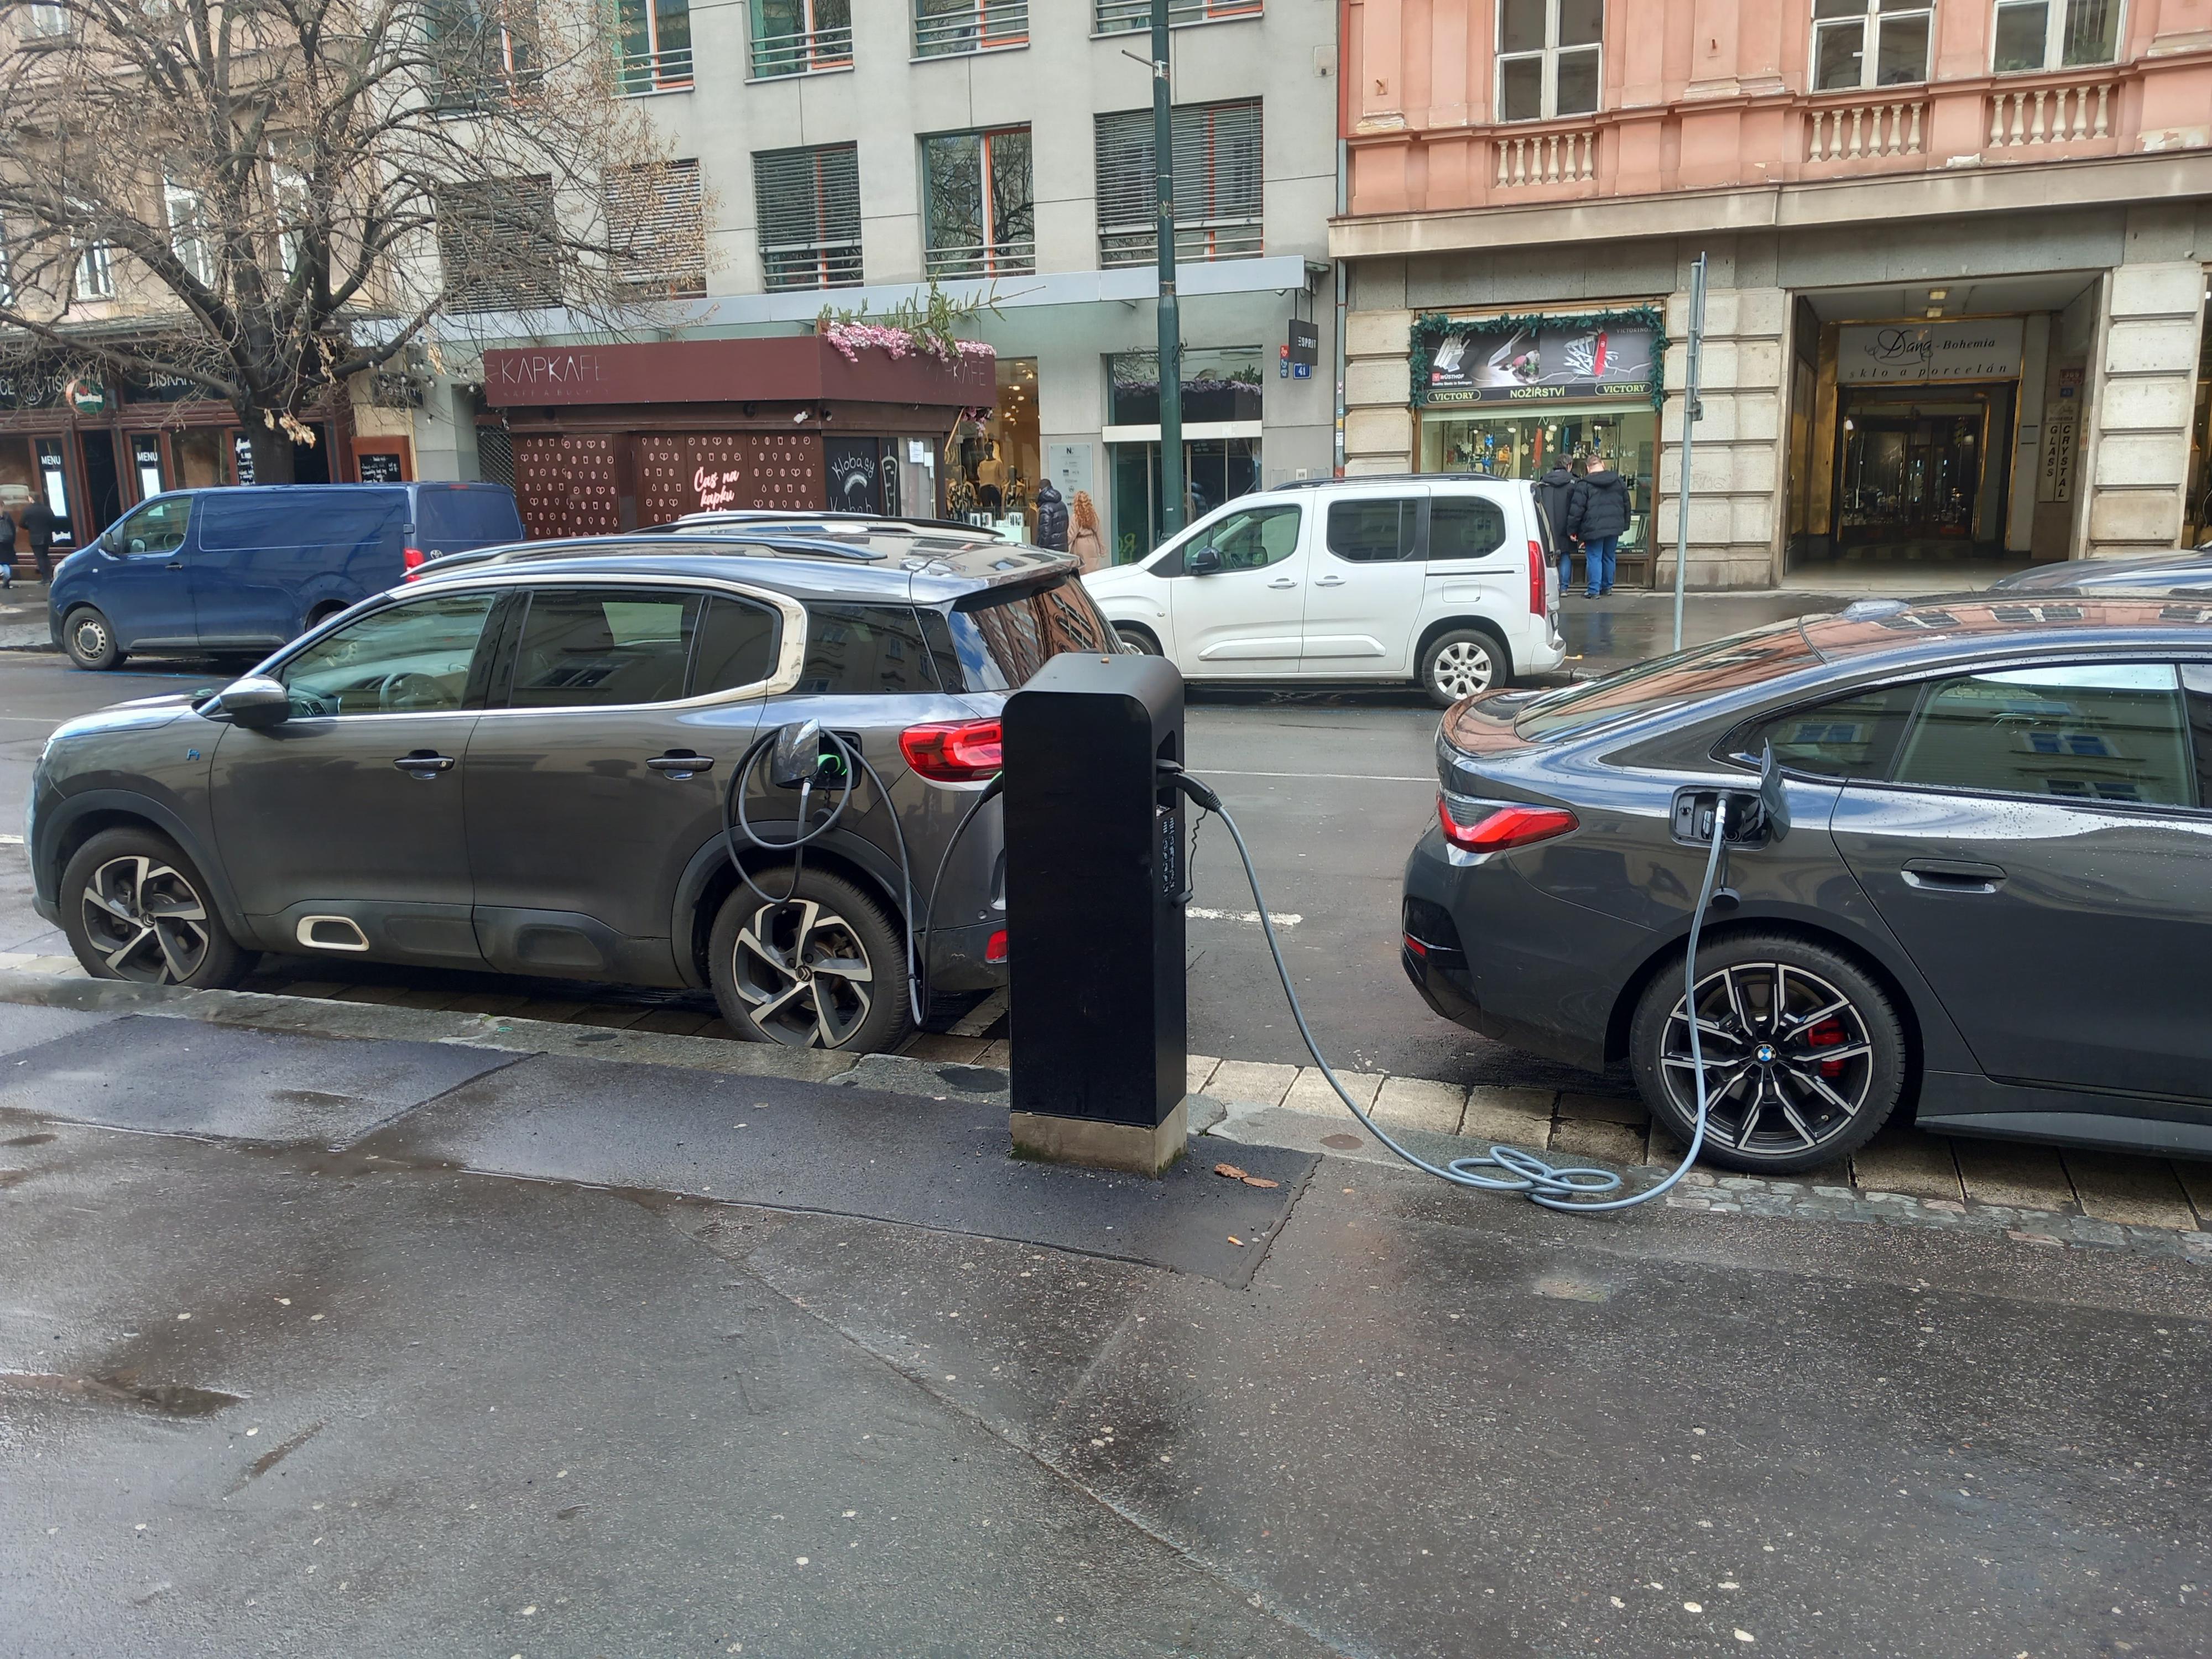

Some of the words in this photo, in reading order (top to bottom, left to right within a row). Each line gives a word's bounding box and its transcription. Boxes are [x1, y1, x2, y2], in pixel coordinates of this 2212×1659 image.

[1298, 336, 1317, 348] ESPRIT
[1877, 328, 1933, 361] Dana
[1943, 338, 1996, 350] Bohemia
[501, 355, 608, 384] KAPKAFE
[1298, 366, 1306, 375] 41
[1850, 368, 1888, 378] sklo
[1918, 363, 2007, 378] porcelán
[1434, 392, 1474, 400] VICTORY
[1510, 386, 1565, 399] NOŽÍŘSTVÍ
[1603, 385, 1646, 393] VICTORY
[137, 452, 158, 461] MENU
[2047, 425, 2058, 477] GLASS
[41, 455, 61, 465] MENU
[831, 451, 875, 481] Klobásy
[2058, 425, 2071, 497] CRYSTAL
[694, 466, 719, 492] Čas
[722, 470, 740, 484] na
[700, 485, 735, 509] kapku
